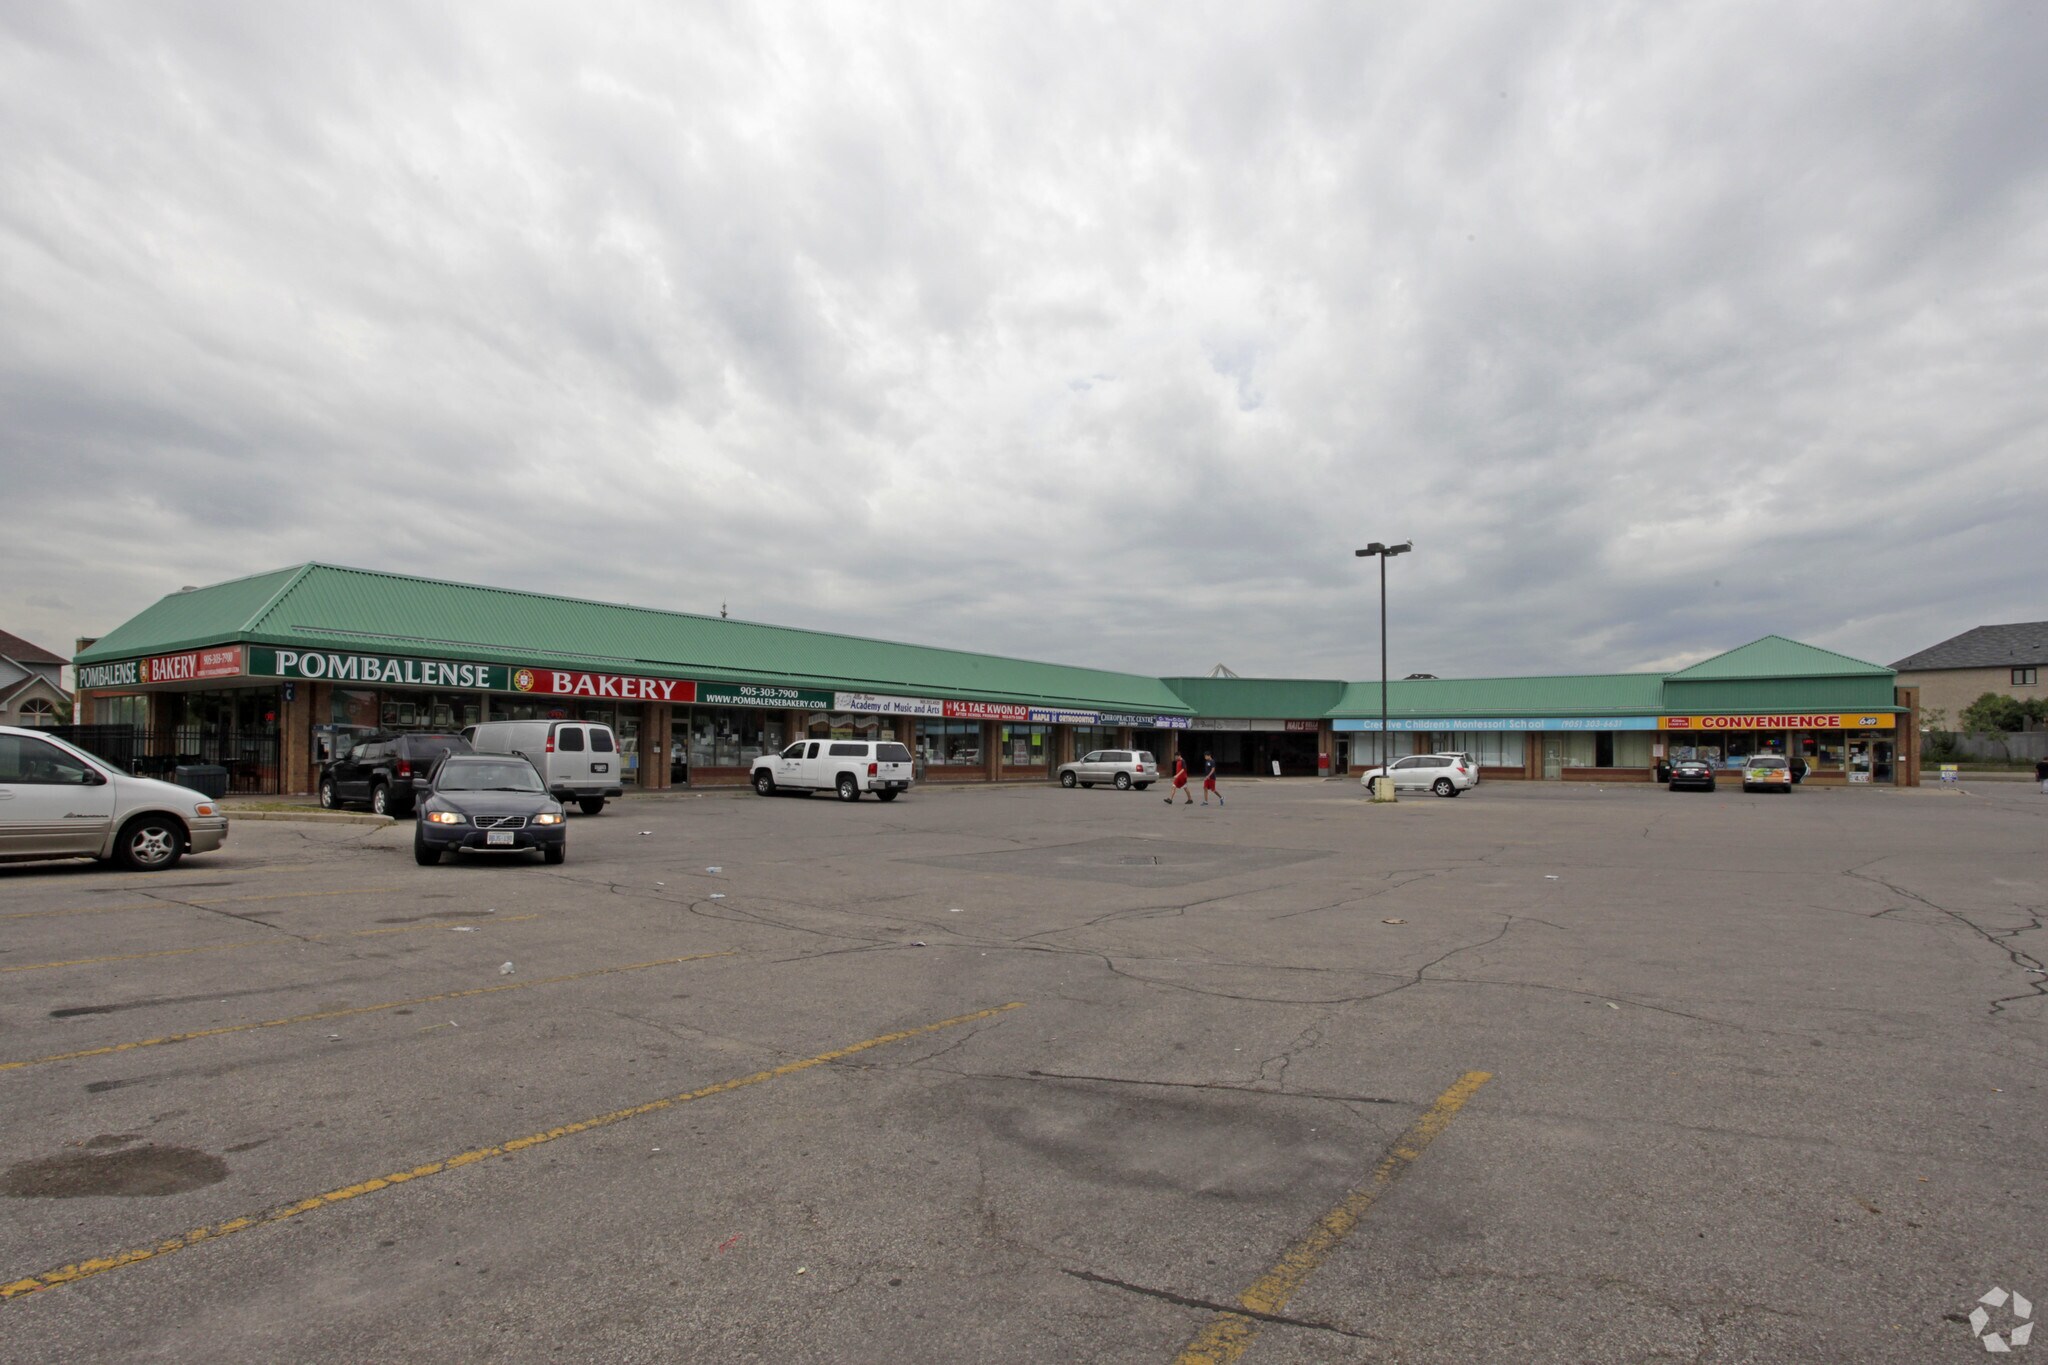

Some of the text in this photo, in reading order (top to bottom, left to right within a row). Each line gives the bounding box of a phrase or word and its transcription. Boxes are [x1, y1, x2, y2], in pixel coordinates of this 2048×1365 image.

[79, 653, 198, 688] POMBALENSE BAKERY
[275, 650, 490, 688] POMBALENSE
[551, 671, 677, 700] BAKERY
[740, 686, 798, 698] 905-303-7900
[706, 694, 827, 709] WWW.POMBALENSEBAKERY.COM
[850, 699, 881, 712] Academy
[883, 701, 890, 711] of
[894, 702, 912, 712] Music
[914, 704, 925, 714] and
[927, 705, 940, 714] Arts
[953, 701, 967, 712] K1
[968, 702, 986, 713] TAE
[987, 704, 1013, 715] KWON
[1014, 706, 1026, 716] DO
[1032, 713, 1050, 721] MAPLE
[1058, 715, 1095, 724] ORTHODONTICS
[1286, 721, 1305, 730] NAILS
[1405, 720, 1450, 729] Children's
[1453, 720, 1506, 729] Montessori
[1509, 719, 1544, 729] School
[1561, 719, 1582, 729] (905)
[1701, 715, 1876, 728] CONVENIENCE 649
